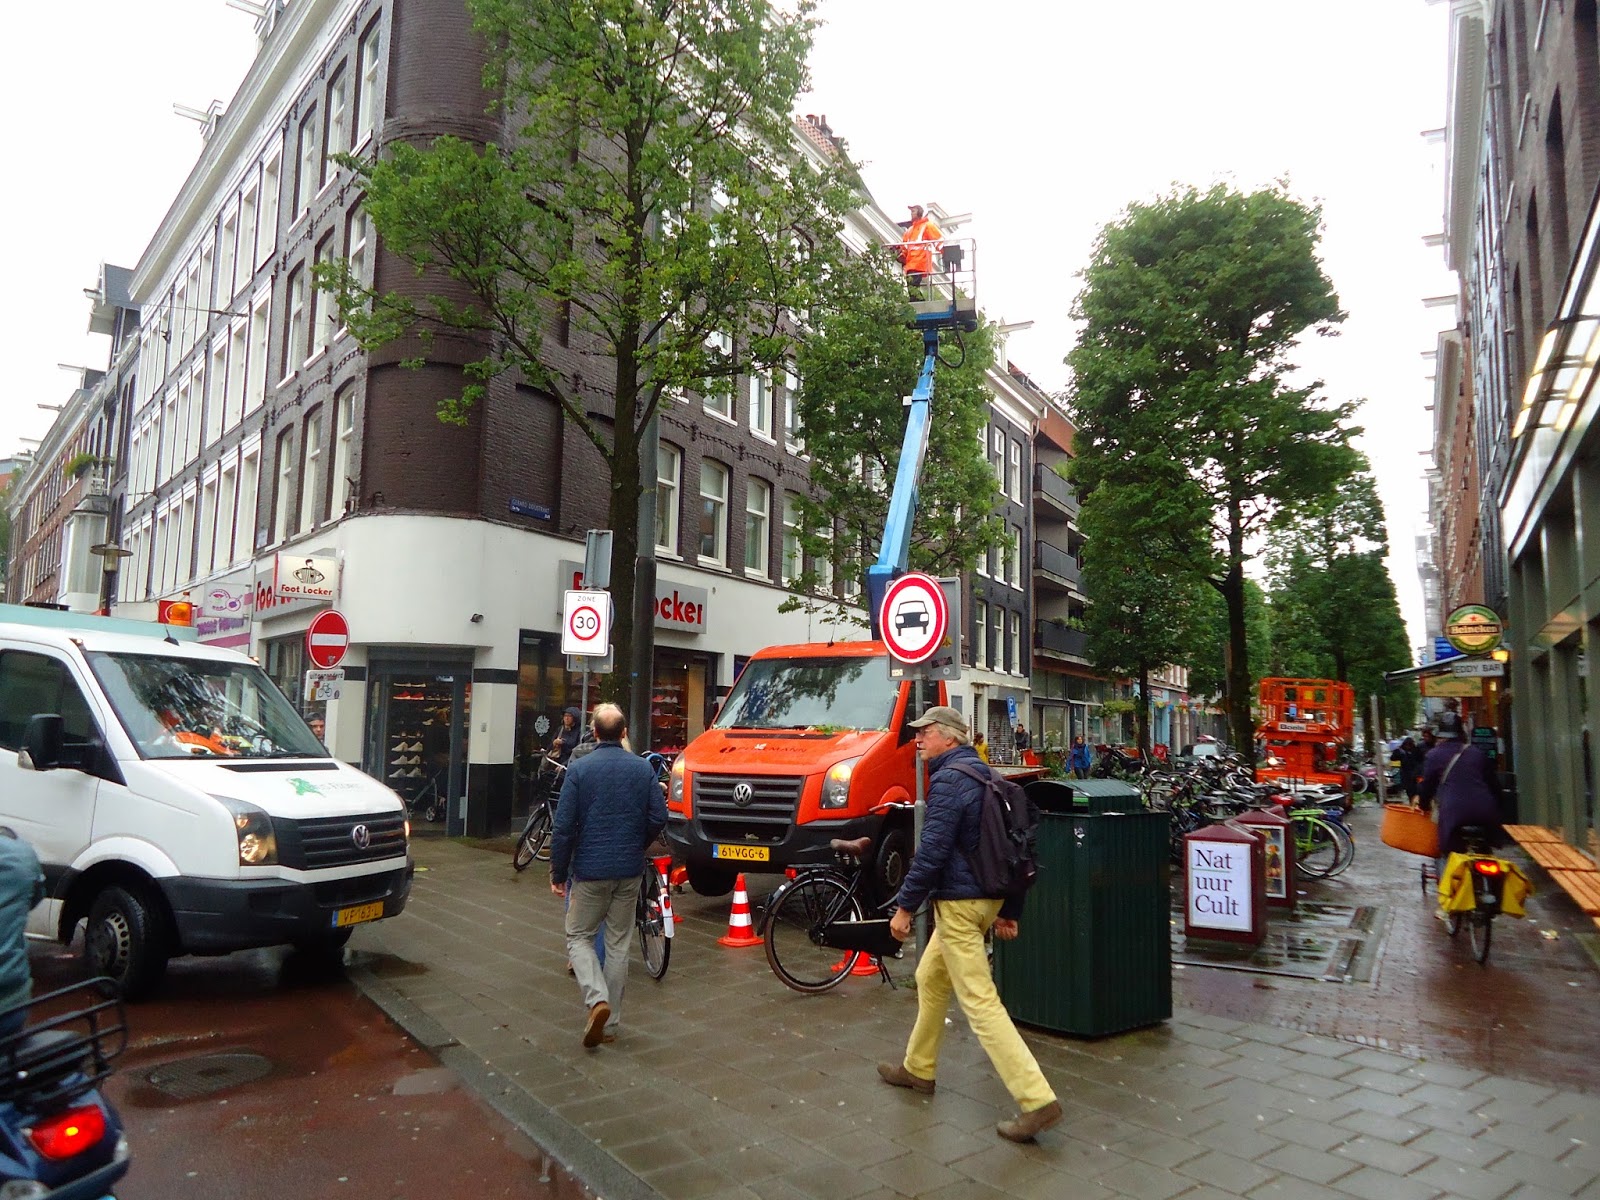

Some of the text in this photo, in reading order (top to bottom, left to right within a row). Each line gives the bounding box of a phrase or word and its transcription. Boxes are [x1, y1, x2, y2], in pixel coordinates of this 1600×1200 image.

[281, 584, 333, 596] Foot Locker
[653, 590, 703, 624] cker
[575, 616, 596, 630] 30
[1451, 625, 1498, 634] Heineken
[1482, 663, 1501, 672] BAR
[721, 847, 765, 859] 61-VGG-6
[1195, 848, 1233, 870] Nat
[1195, 876, 1233, 892] uur
[1195, 894, 1239, 916] Cult
